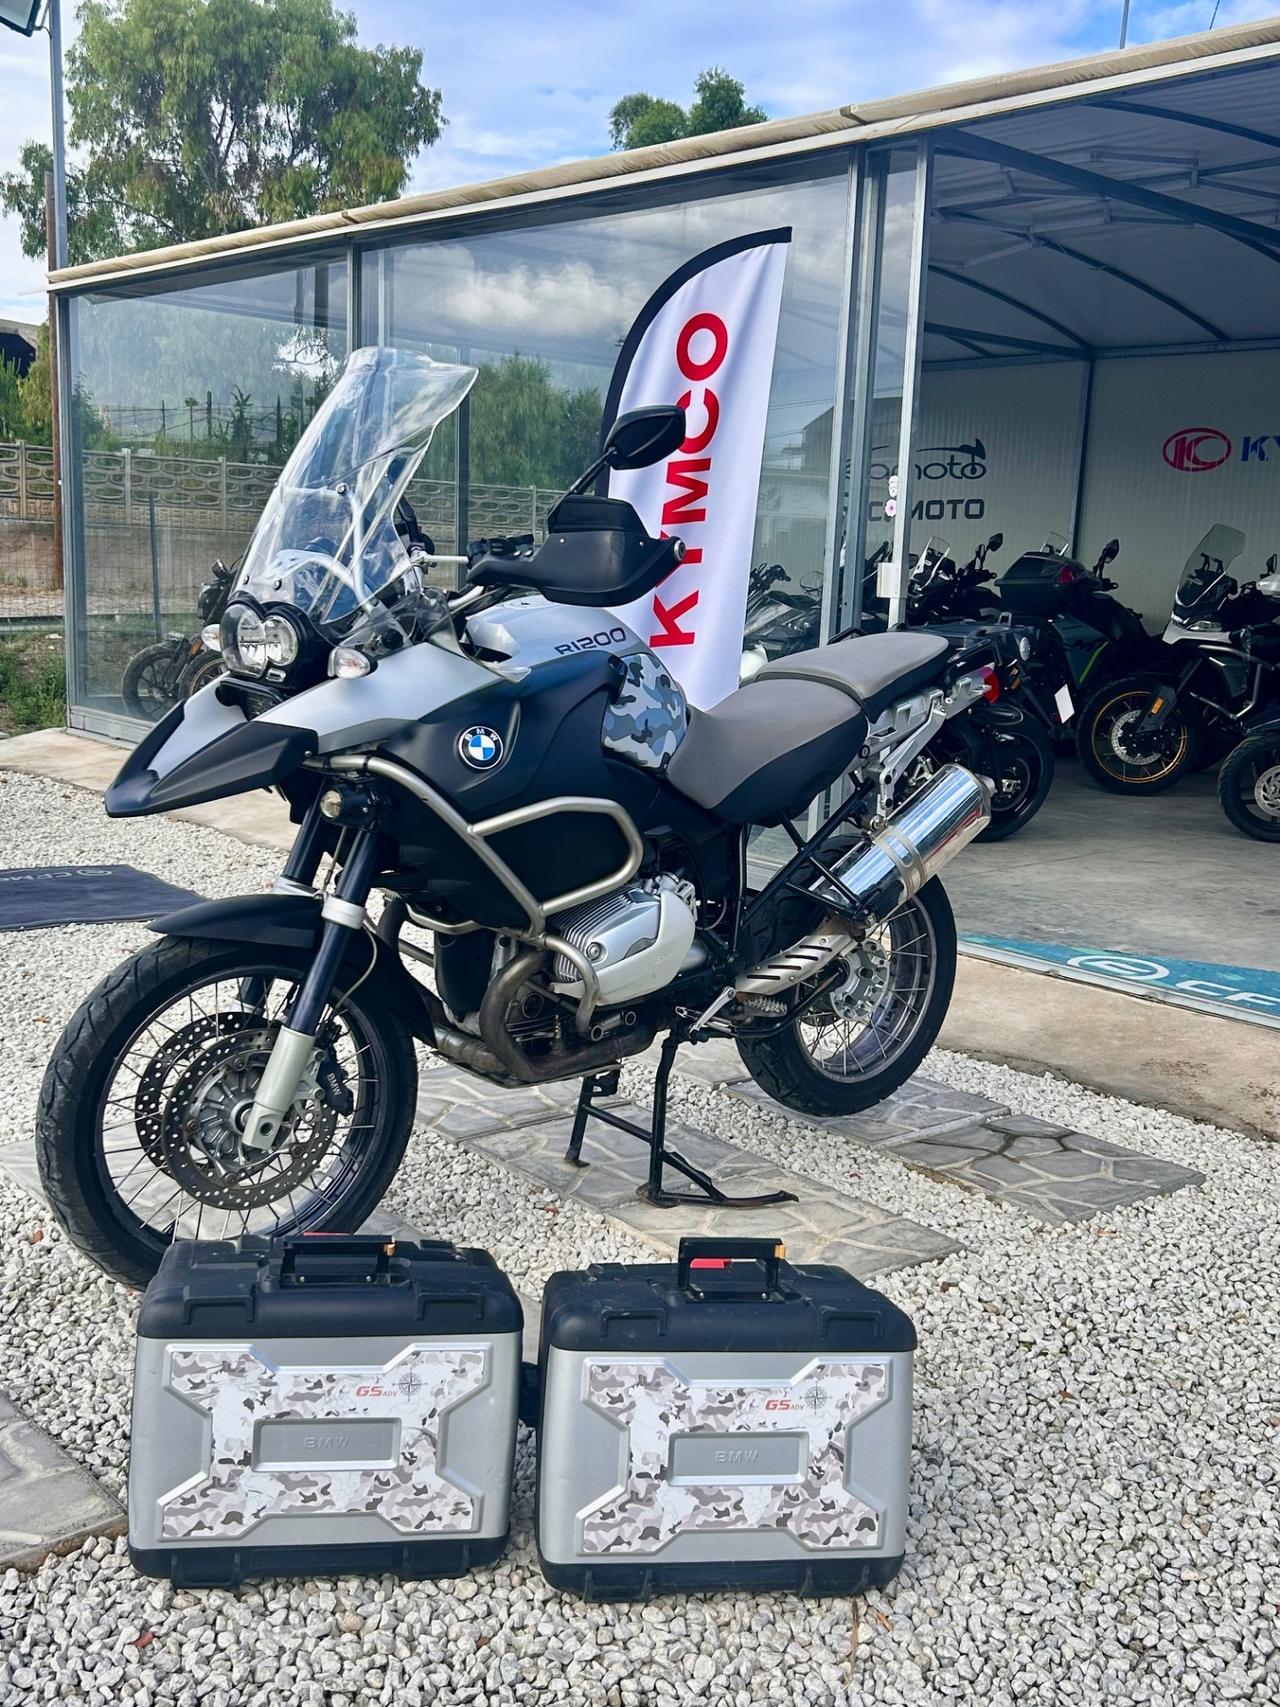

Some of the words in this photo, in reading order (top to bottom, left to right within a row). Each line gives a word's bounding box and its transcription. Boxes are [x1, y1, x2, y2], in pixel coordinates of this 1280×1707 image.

[1241, 435, 1280, 462] K
[553, 627, 627, 655] R1200
[464, 728, 500, 741] BMW
[327, 1072, 342, 1096] BMW
[355, 1385, 384, 1397] GS
[383, 1390, 398, 1398] ADV
[765, 1399, 791, 1410] GS
[790, 1403, 805, 1411] ADV
[303, 1436, 350, 1449] BMW
[715, 1450, 759, 1464] BMW
